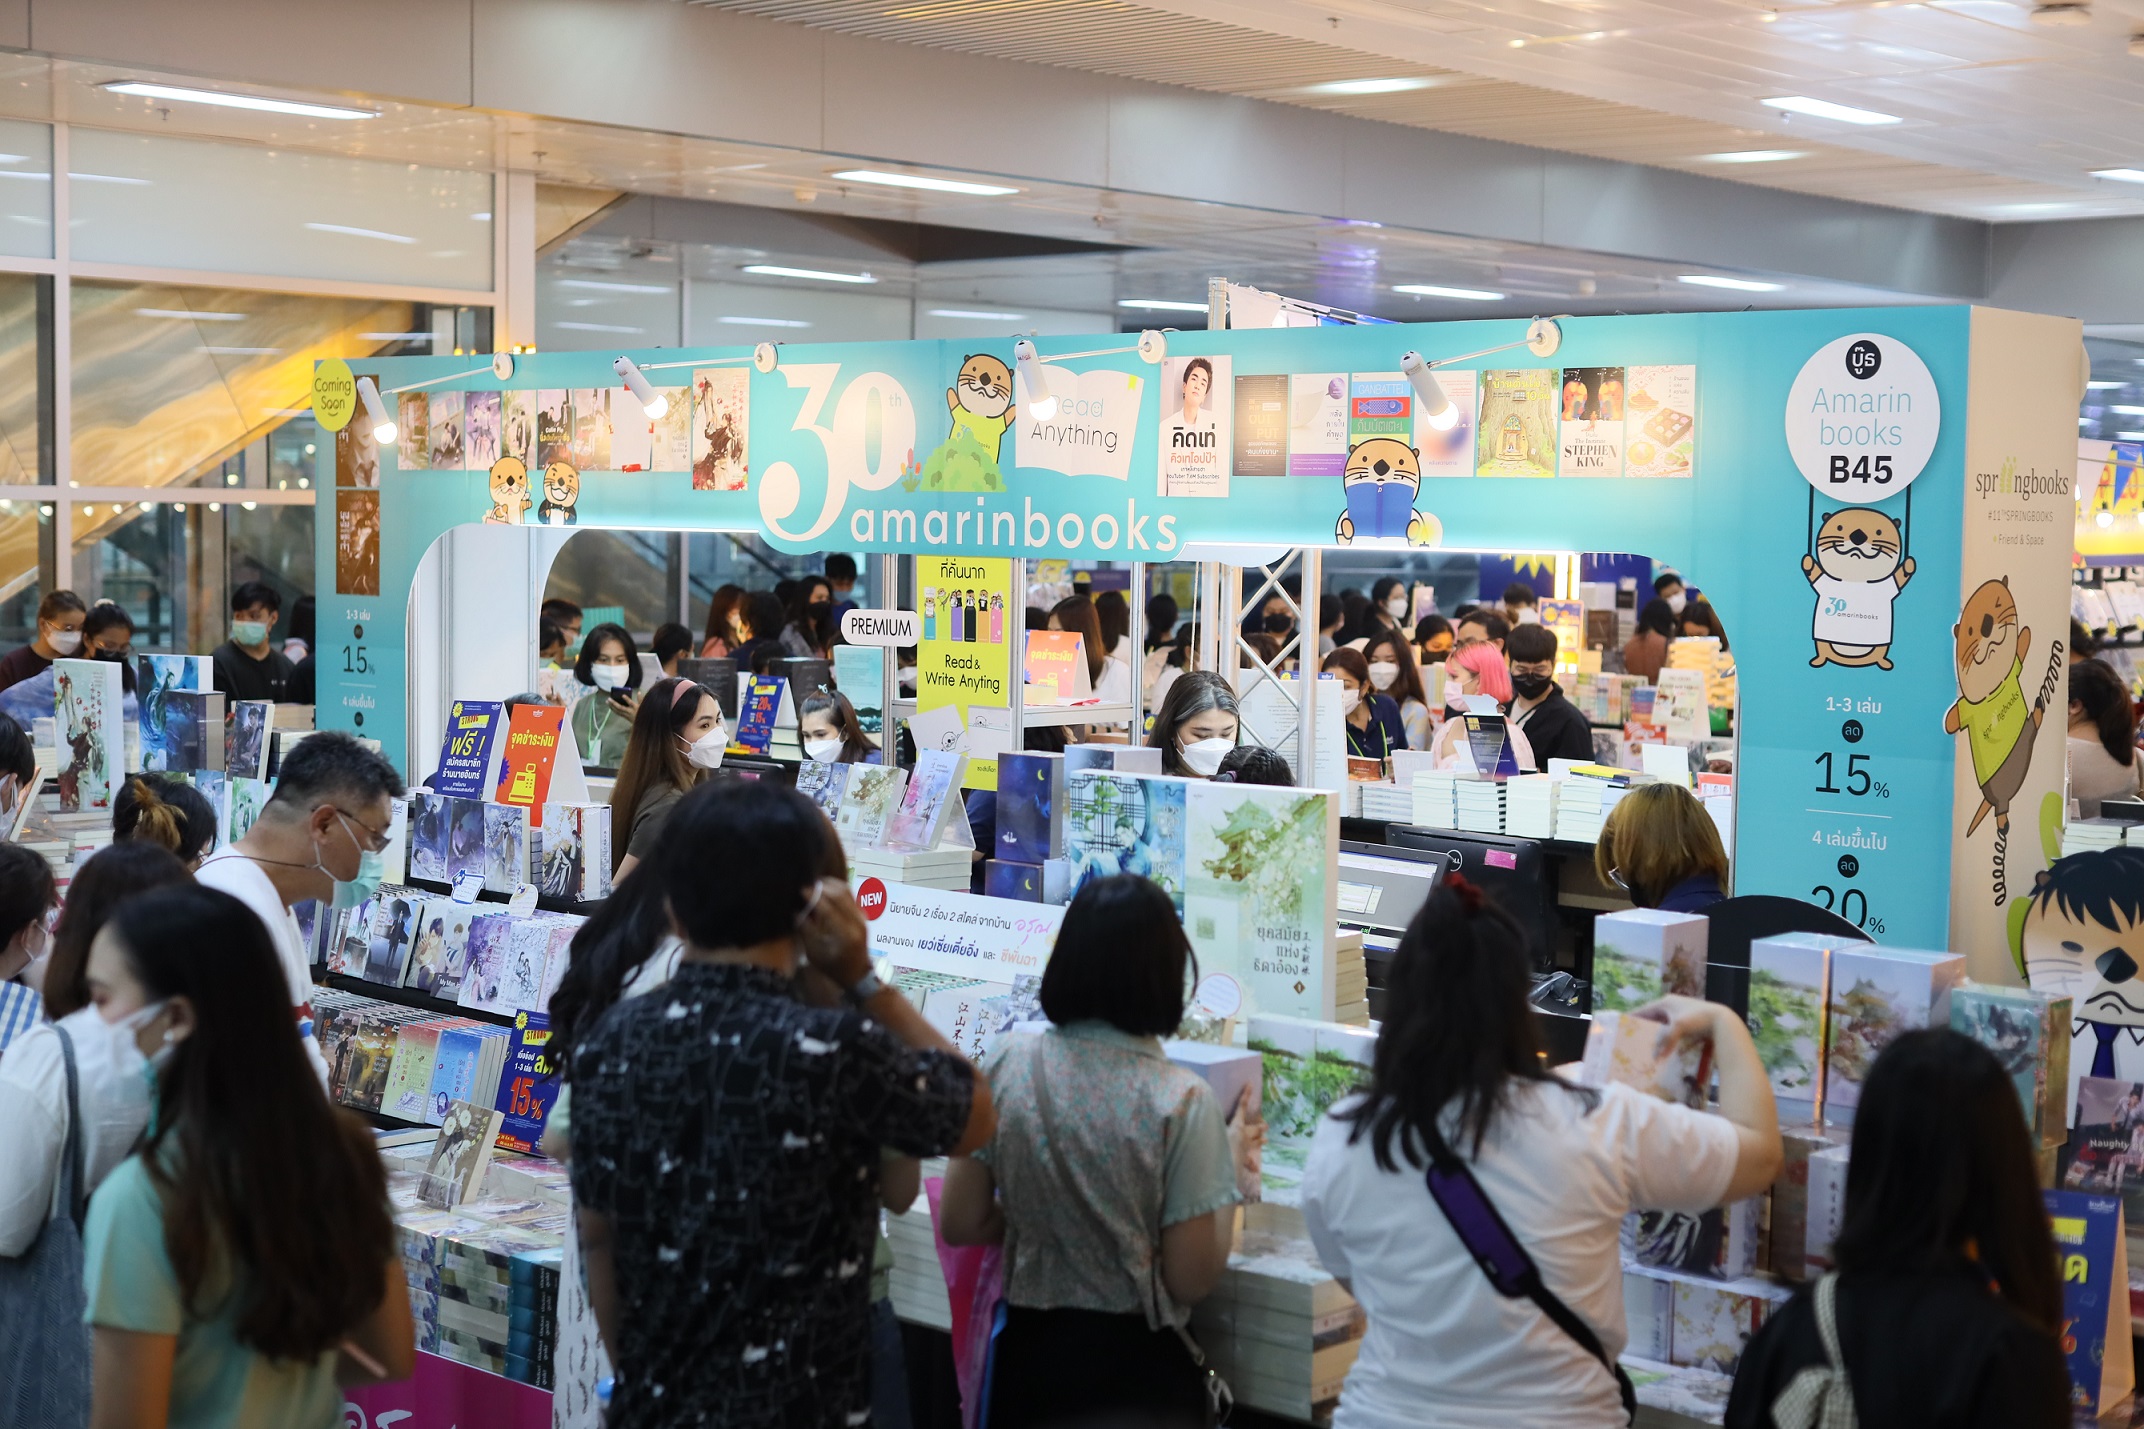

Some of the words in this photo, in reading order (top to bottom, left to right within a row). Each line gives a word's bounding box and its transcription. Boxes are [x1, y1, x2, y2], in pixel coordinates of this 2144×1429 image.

[314, 377, 351, 396] Coming
[1525, 390, 1537, 401] 10
[320, 396, 346, 410] Soon
[1811, 386, 1912, 414] Amarin
[1030, 421, 1119, 453] Anything
[1172, 422, 1216, 448] คิดเท่
[1256, 428, 1280, 438] PUT
[1819, 418, 1903, 446] books
[1564, 443, 1617, 459] STEPHEN
[1576, 456, 1604, 467] KING
[1829, 454, 1893, 484] B45
[850, 496, 1177, 552] amarinbooks
[940, 558, 986, 580] ที่คั่นนาก
[1837, 612, 1879, 620] amarinbooks
[850, 617, 912, 637] PREMIUM
[945, 654, 973, 670] Read
[974, 659, 981, 670] &
[925, 672, 956, 687] Write
[959, 674, 1000, 694] Anyting
[1825, 697, 1853, 713] 1-3
[1856, 696, 1882, 715] เล่ม
[511, 729, 555, 750] จุดชำระเงิน
[1844, 726, 1860, 737] ลด
[450, 730, 479, 756] ฟรี
[476, 736, 487, 757] !
[1814, 751, 1890, 799] 15%
[1812, 833, 1822, 845] 4
[1826, 826, 1888, 851] เล่มขึ้นไป
[1840, 859, 1856, 872] ลด
[860, 891, 883, 908] NEW
[889, 902, 922, 918] นิยายจีน
[923, 908, 929, 918] 2
[930, 904, 949, 922] เรื่อง
[949, 912, 956, 922] 2
[978, 915, 1011, 930] จากบ้าน
[1256, 925, 1301, 942] ยุคสมัย
[876, 933, 915, 948] ผลงานของ
[983, 950, 997, 961] และ
[1276, 942, 1300, 958] แห่ง
[514, 1062, 524, 1072] 1-3
[509, 1076, 544, 1121] 15%
[2090, 1139, 2130, 1151] Naughty
